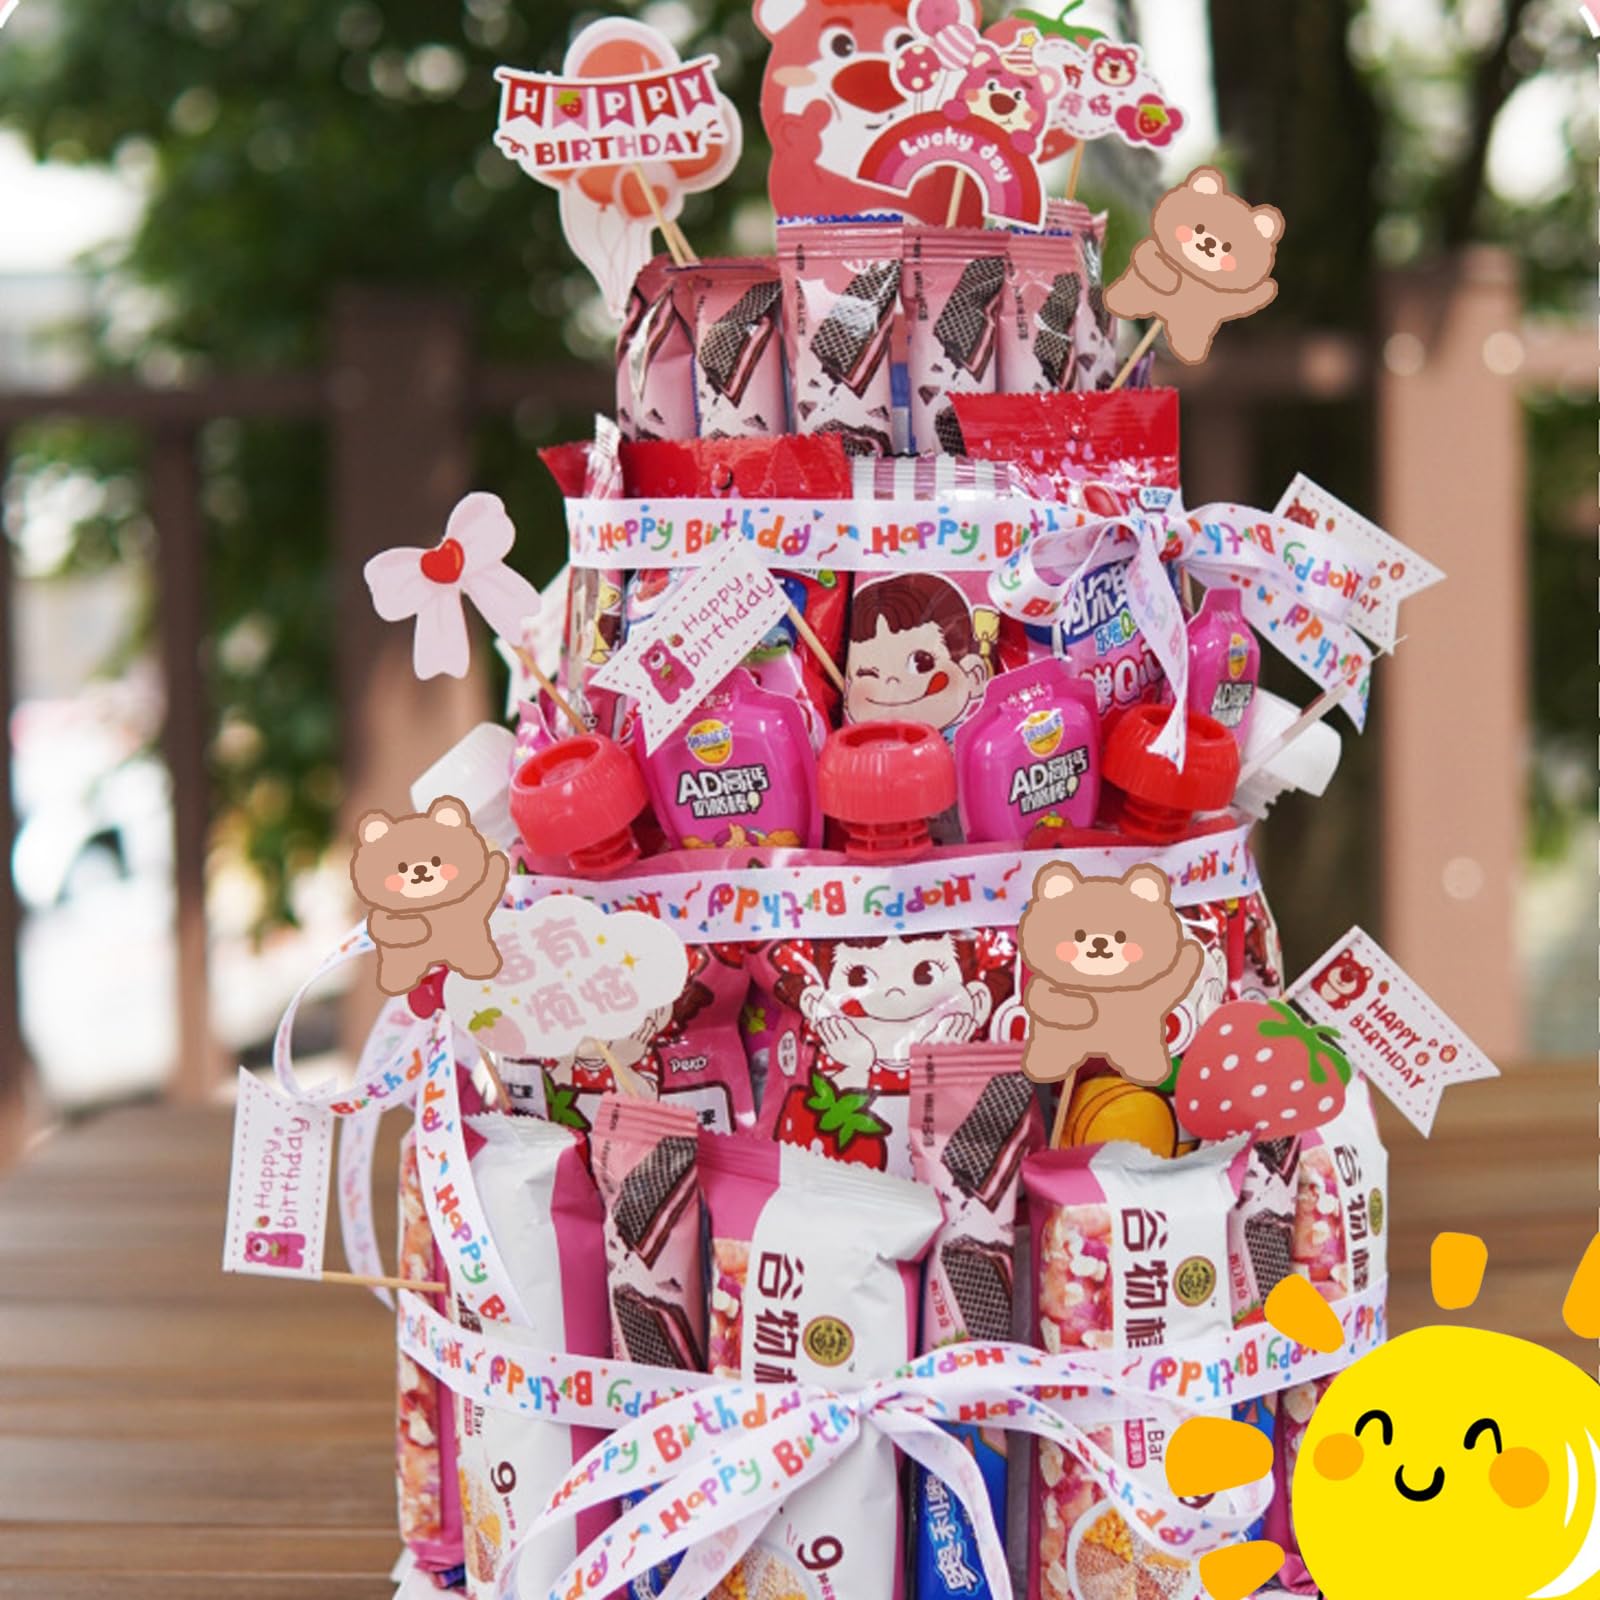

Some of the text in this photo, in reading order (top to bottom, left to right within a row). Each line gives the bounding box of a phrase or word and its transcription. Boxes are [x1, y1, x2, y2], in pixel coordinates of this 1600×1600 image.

[514, 76, 704, 117] HPPY
[534, 130, 703, 167] BIRTHDAY
[899, 126, 1013, 184] Lucky day
[598, 515, 673, 551] Happy
[686, 507, 812, 556] Birthday
[872, 518, 979, 555] Happy
[1284, 541, 1363, 600] Happy
[682, 579, 745, 634] Happy
[685, 572, 775, 668] birthday
[707, 881, 846, 929] Birthday
[862, 874, 973, 919] Happy
[1349, 1013, 1425, 1089] BIRTHDAY
[1366, 997, 1422, 1049] HAPPY
[253, 1139, 282, 1210] Happy
[276, 1115, 311, 1230] birthday
[435, 1184, 489, 1284] Happy
[490, 1355, 593, 1414] Birthday
[1148, 1339, 1259, 1398] Birthday
[659, 1456, 762, 1535] Happy
[772, 1402, 853, 1478] Birth
[1147, 1429, 1165, 1463] Bar
[548, 1439, 638, 1514] Happy
